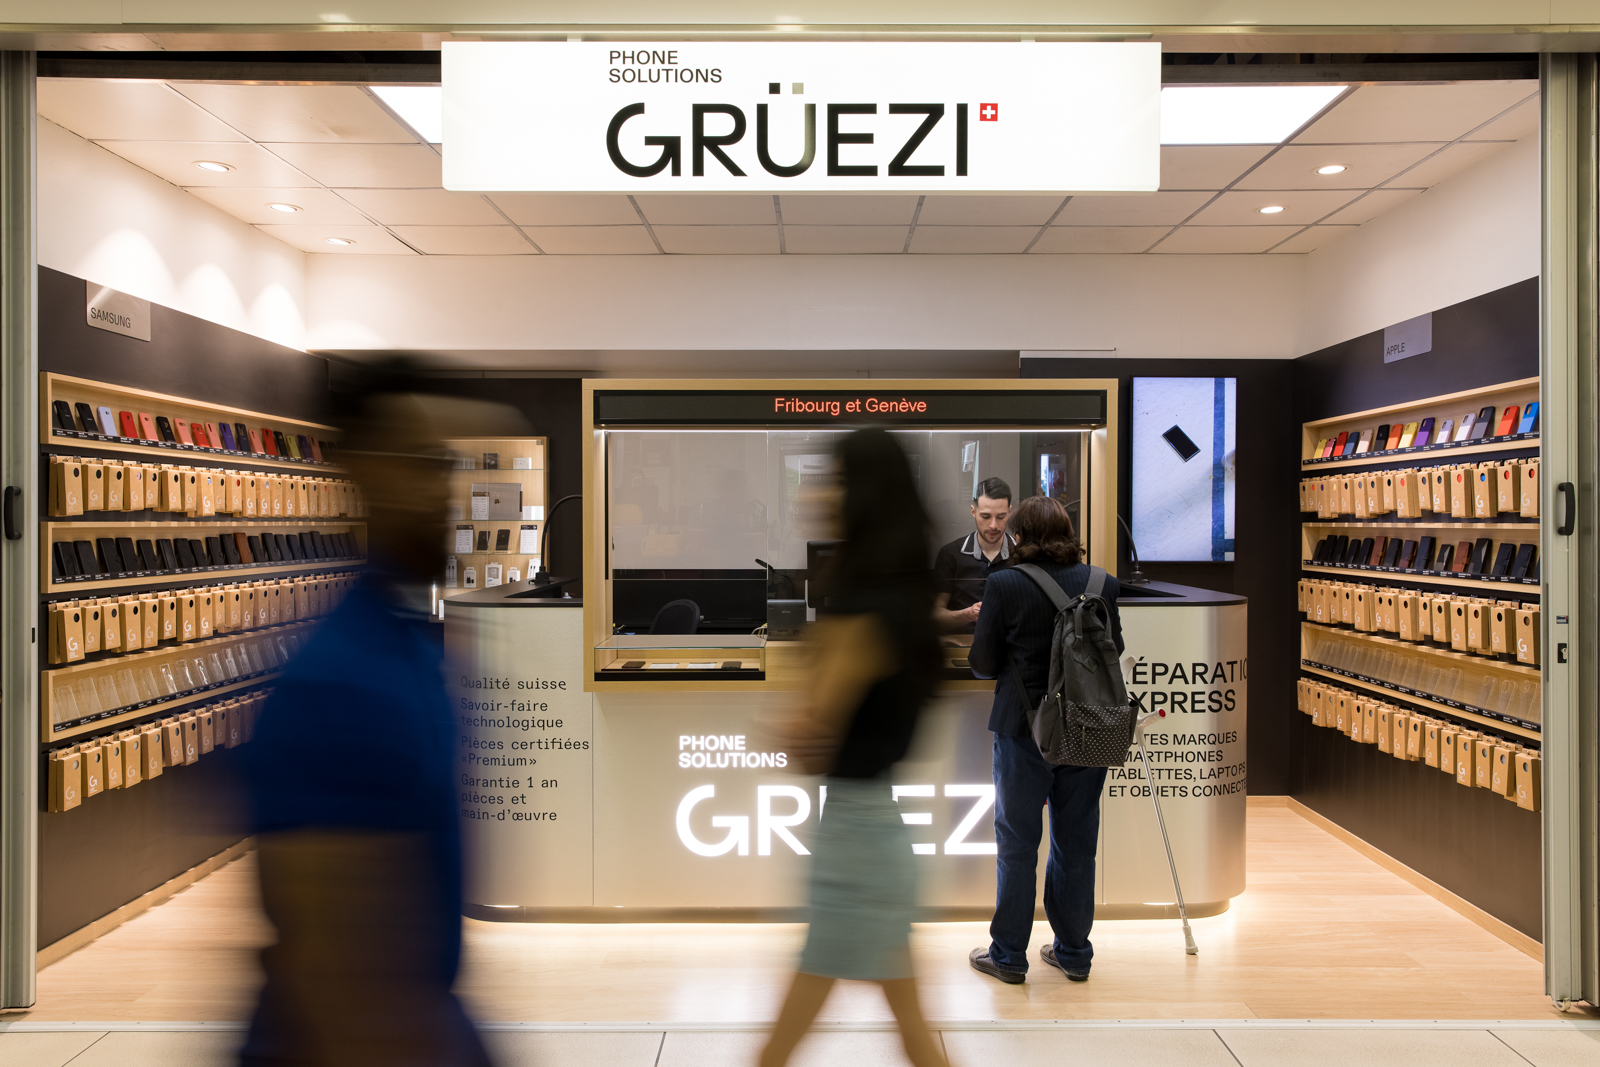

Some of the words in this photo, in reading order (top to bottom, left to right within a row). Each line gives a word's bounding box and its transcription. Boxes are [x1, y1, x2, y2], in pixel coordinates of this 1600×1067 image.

[609, 50, 678, 65] PHONE
[609, 68, 722, 83] SOLUTIONS
[606, 82, 968, 177] GRÜEZI
[91, 307, 131, 328] SAMSUNG
[1386, 342, 1405, 356] APPLE
[775, 398, 840, 416] Fribourg
[845, 399, 861, 412] et
[865, 398, 927, 412] Genève
[67, 491, 77, 505] G
[90, 489, 98, 501] G
[110, 490, 118, 502] G
[132, 491, 139, 501] G
[147, 490, 153, 499] G
[170, 492, 176, 502] G
[186, 493, 192, 503] G
[216, 495, 221, 504] G
[233, 495, 239, 504] G
[1384, 494, 1389, 502] G
[1419, 493, 1425, 502] G
[1434, 494, 1440, 505] G
[1499, 491, 1506, 502] G
[1522, 493, 1530, 506] G
[203, 496, 210, 508] G
[247, 498, 253, 509] G
[261, 499, 267, 509] G
[274, 499, 280, 509] G
[287, 500, 292, 509] G
[300, 500, 305, 510] G
[310, 501, 315, 510] G
[321, 501, 326, 510] G
[332, 501, 336, 510] G
[1318, 502, 1323, 511] G
[1330, 498, 1335, 507] G
[1342, 498, 1346, 507] G
[1355, 500, 1361, 510] G
[1368, 497, 1374, 507] G
[1397, 498, 1404, 510] G
[1452, 496, 1459, 508] G
[1476, 495, 1484, 508] G
[271, 607, 276, 617] G
[286, 605, 292, 615] G
[301, 603, 306, 612] G
[1307, 604, 1312, 614] G
[1317, 605, 1322, 615] G
[1331, 605, 1335, 614] G
[1343, 607, 1347, 616] G
[216, 611, 221, 619] G
[232, 611, 237, 620] G
[244, 611, 250, 621] G
[260, 608, 266, 619] G
[1355, 612, 1360, 622] G
[1376, 612, 1381, 622] G
[1385, 614, 1390, 624] G
[165, 620, 172, 631] G
[184, 620, 191, 632] G
[202, 617, 209, 629] G
[1400, 620, 1406, 631] G
[1420, 617, 1425, 627] G
[1434, 622, 1440, 633] G
[87, 632, 94, 643] G
[106, 629, 114, 640] G
[128, 629, 136, 642] G
[146, 626, 153, 639] G
[1452, 628, 1460, 641] G
[1469, 628, 1476, 639] G
[1492, 632, 1499, 643] G
[68, 637, 78, 651] G
[1518, 638, 1527, 653] G
[461, 676, 510, 690] Qualité
[517, 678, 567, 690] suisse
[461, 697, 548, 711] Savoir-faire
[1129, 689, 1236, 714] XPRESS
[1313, 708, 1318, 718] G
[1326, 710, 1331, 719] G
[461, 715, 563, 731] technologique
[1337, 715, 1342, 724] G
[217, 729, 222, 737] G
[231, 728, 237, 739] G
[1352, 722, 1357, 734] G
[1364, 724, 1369, 734] G
[203, 736, 209, 745] G
[461, 735, 504, 750] Pièces
[511, 738, 590, 750] certifiées
[679, 735, 746, 750] PHONE
[1173, 731, 1237, 745] MARQUES
[1378, 732, 1384, 744] G
[1408, 738, 1413, 748] G
[1394, 738, 1400, 750] G
[172, 747, 179, 757] G
[187, 744, 194, 756] G
[1426, 747, 1432, 758] G
[461, 752, 537, 766] «Premium»
[678, 752, 788, 768] SOLUTIONS
[1125, 750, 1223, 762] MARTPHONES
[1442, 753, 1448, 765] G
[150, 757, 157, 769] G
[110, 768, 117, 780] G
[127, 765, 136, 778] G
[1200, 762, 1246, 779] LAPTOPS
[1458, 762, 1466, 776] G
[1477, 766, 1483, 778] G
[89, 775, 97, 787] G
[461, 773, 520, 788] Garantie
[527, 776, 534, 788] 1
[541, 779, 558, 788] an
[1493, 772, 1500, 785] G
[66, 786, 75, 800] G
[1109, 785, 1128, 797] ET
[1517, 784, 1527, 799] G
[461, 791, 504, 805] pièces
[511, 793, 527, 804] et
